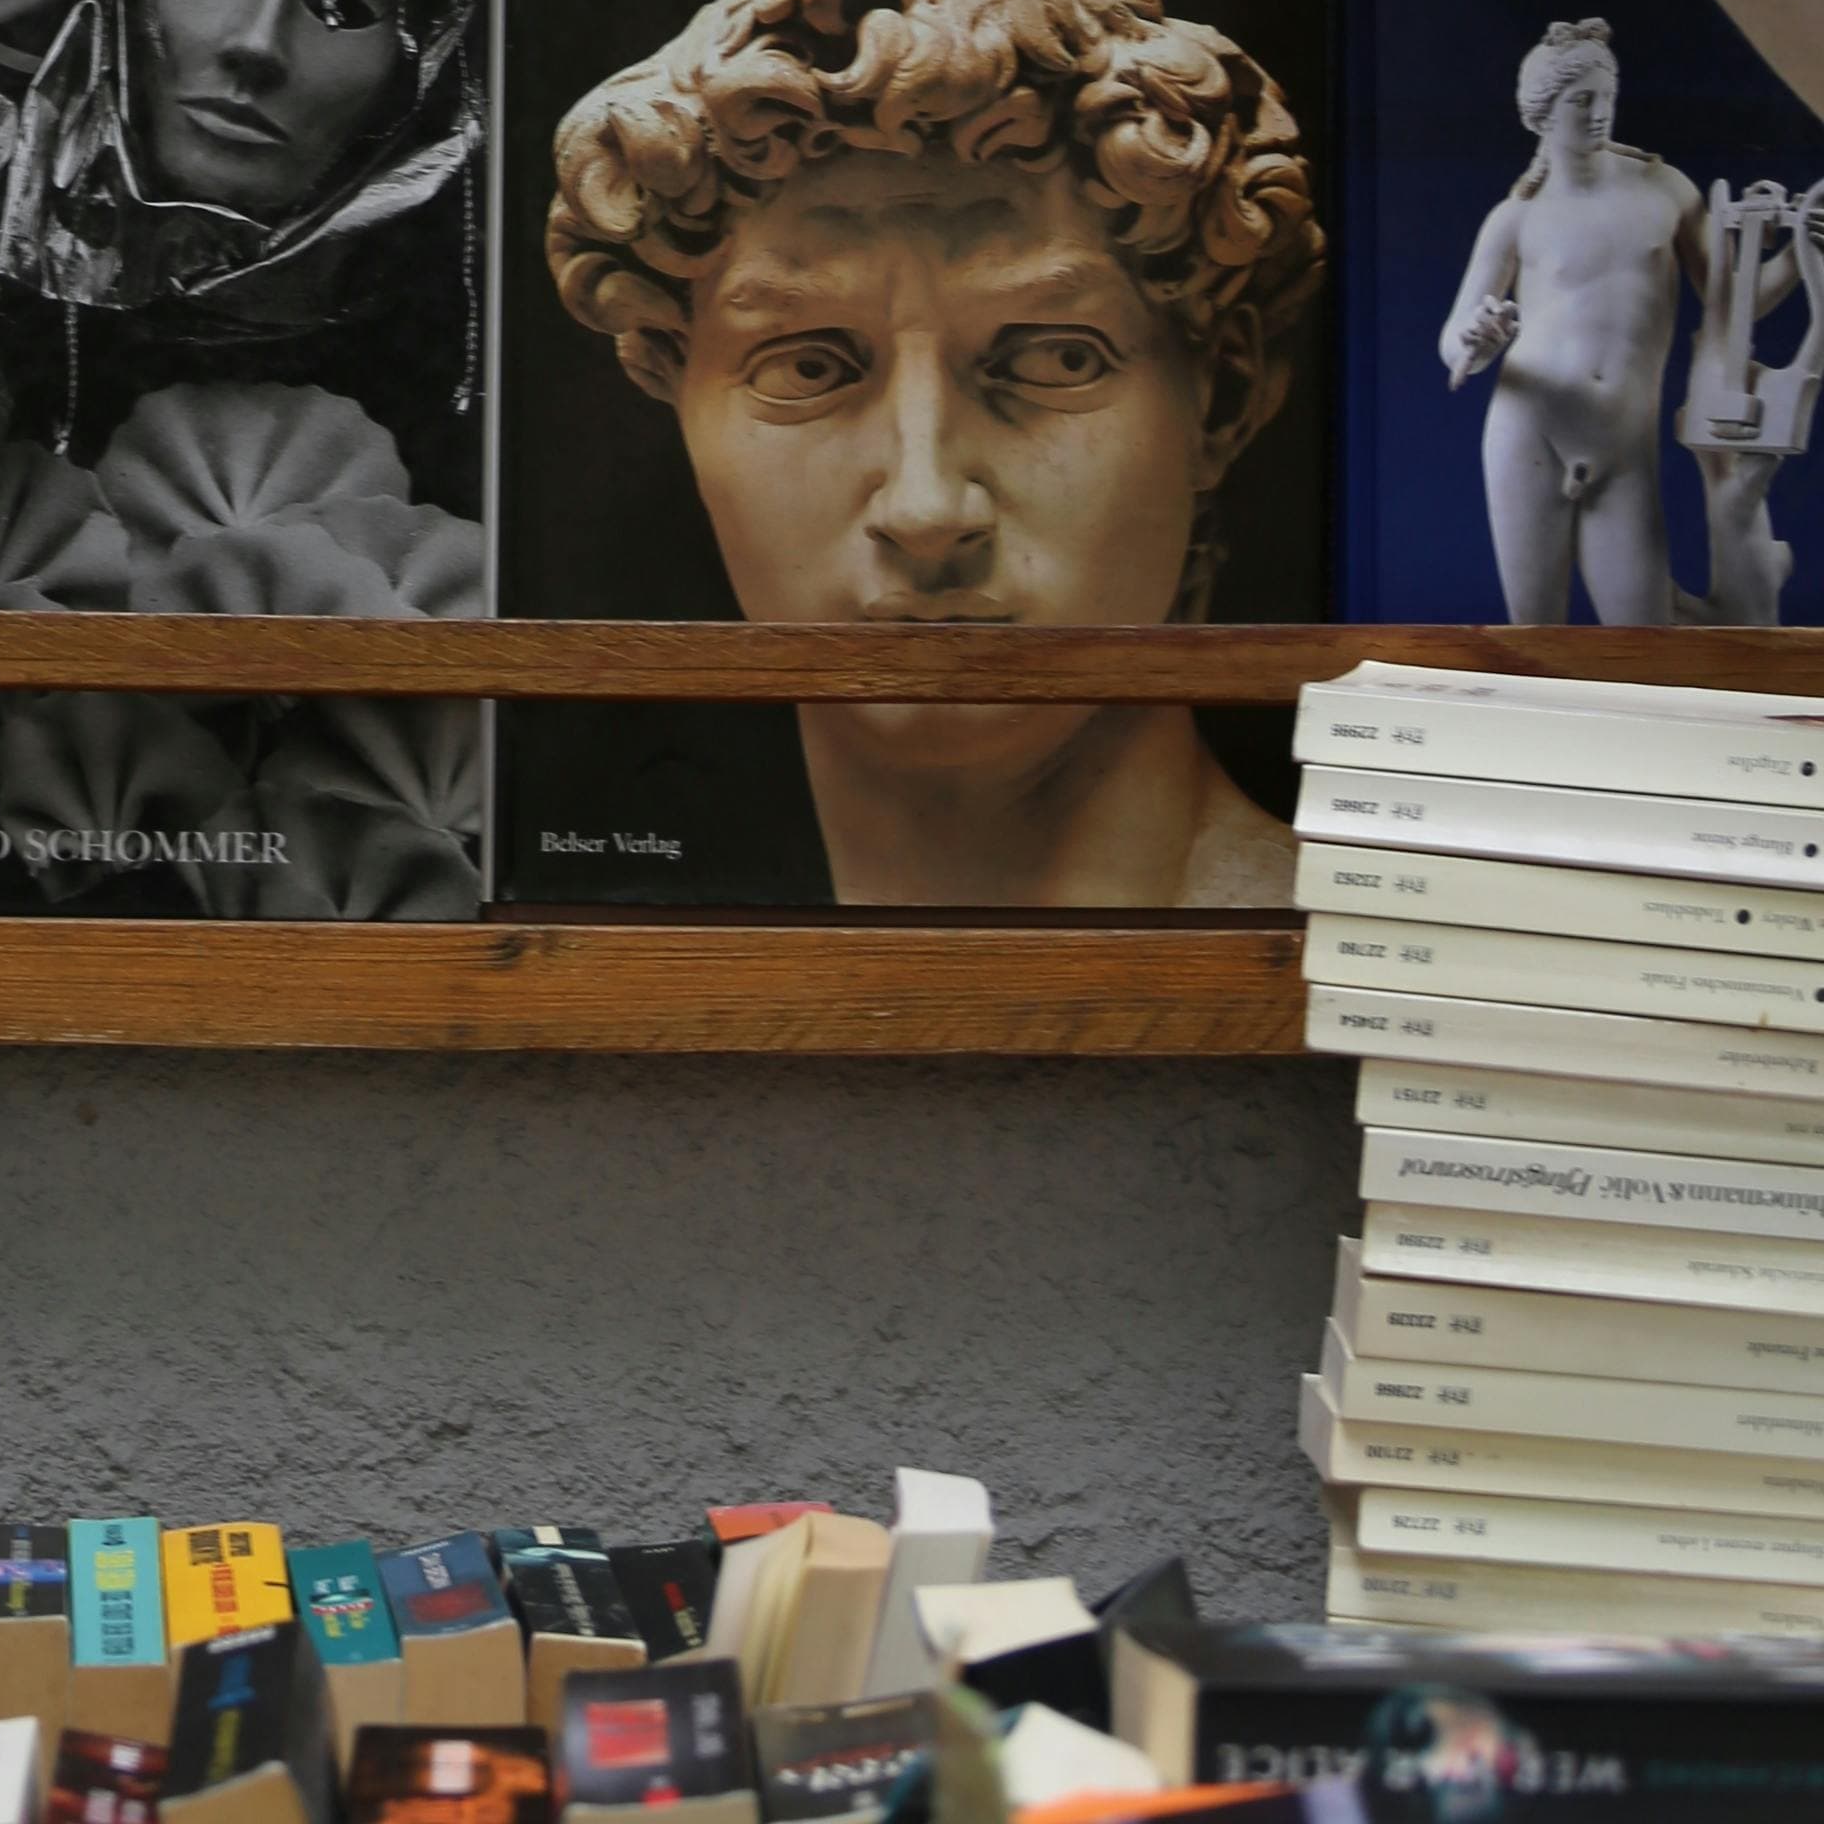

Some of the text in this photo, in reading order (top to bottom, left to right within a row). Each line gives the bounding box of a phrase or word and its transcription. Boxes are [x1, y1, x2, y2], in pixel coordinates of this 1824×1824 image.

[24, 828, 290, 869] SCHOMMER
[540, 831, 681, 862] Belser Verlag
